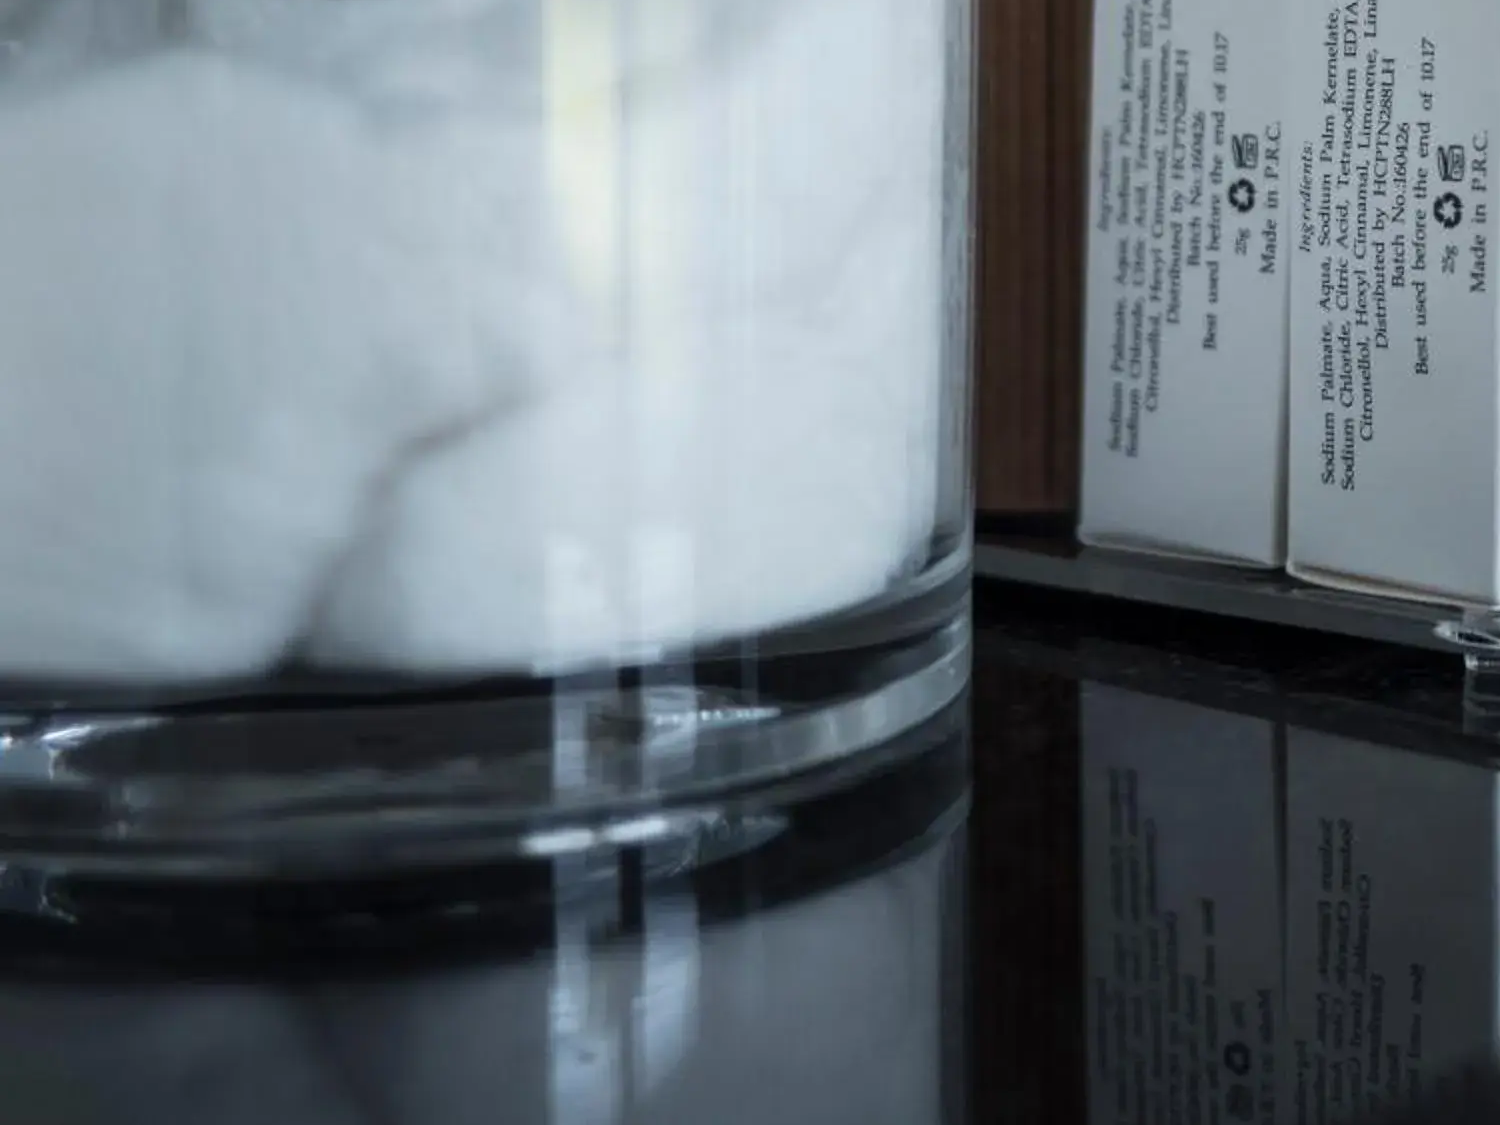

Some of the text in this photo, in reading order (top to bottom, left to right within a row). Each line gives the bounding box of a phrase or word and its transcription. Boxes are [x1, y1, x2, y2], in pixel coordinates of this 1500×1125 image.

[1322, 9, 1340, 104] Kernelate,
[1213, 82, 1227, 101] of
[1357, 49, 1377, 148] Limonene,
[1212, 111, 1226, 145] end
[1319, 115, 1334, 162] Palm
[1337, 69, 1357, 187] Tetrasodium
[1209, 155, 1223, 184] the
[1258, 120, 1281, 274] Made in P.R.C.
[1171, 190, 1186, 213] by
[1205, 194, 1221, 251] before
[1317, 174, 1332, 246] Sodium
[1336, 200, 1350, 249] Acid,
[1354, 161, 1369, 259] Cinnamal,
[1372, 208, 1388, 230] by
[1412, 37, 1435, 375] Best used before the end of 10.17
[1470, 130, 1487, 293] Made in P.R.C.
[1187, 217, 1202, 266] Batch
[1235, 228, 1251, 256] 25g
[1391, 234, 1405, 287] Batch
[1167, 222, 1182, 324] Distributed
[1205, 261, 1219, 304] used
[1319, 257, 1334, 311] Aqua,
[1336, 257, 1348, 311] Citric
[1354, 270, 1370, 326] Hexyl
[1372, 242, 1388, 349] Distributed
[1202, 313, 1217, 350] Best
[1338, 321, 1353, 407] Chloride,
[1357, 337, 1373, 442] Citronellol,
[1321, 412, 1335, 485] Sodium
[1341, 418, 1355, 491] Sodium
